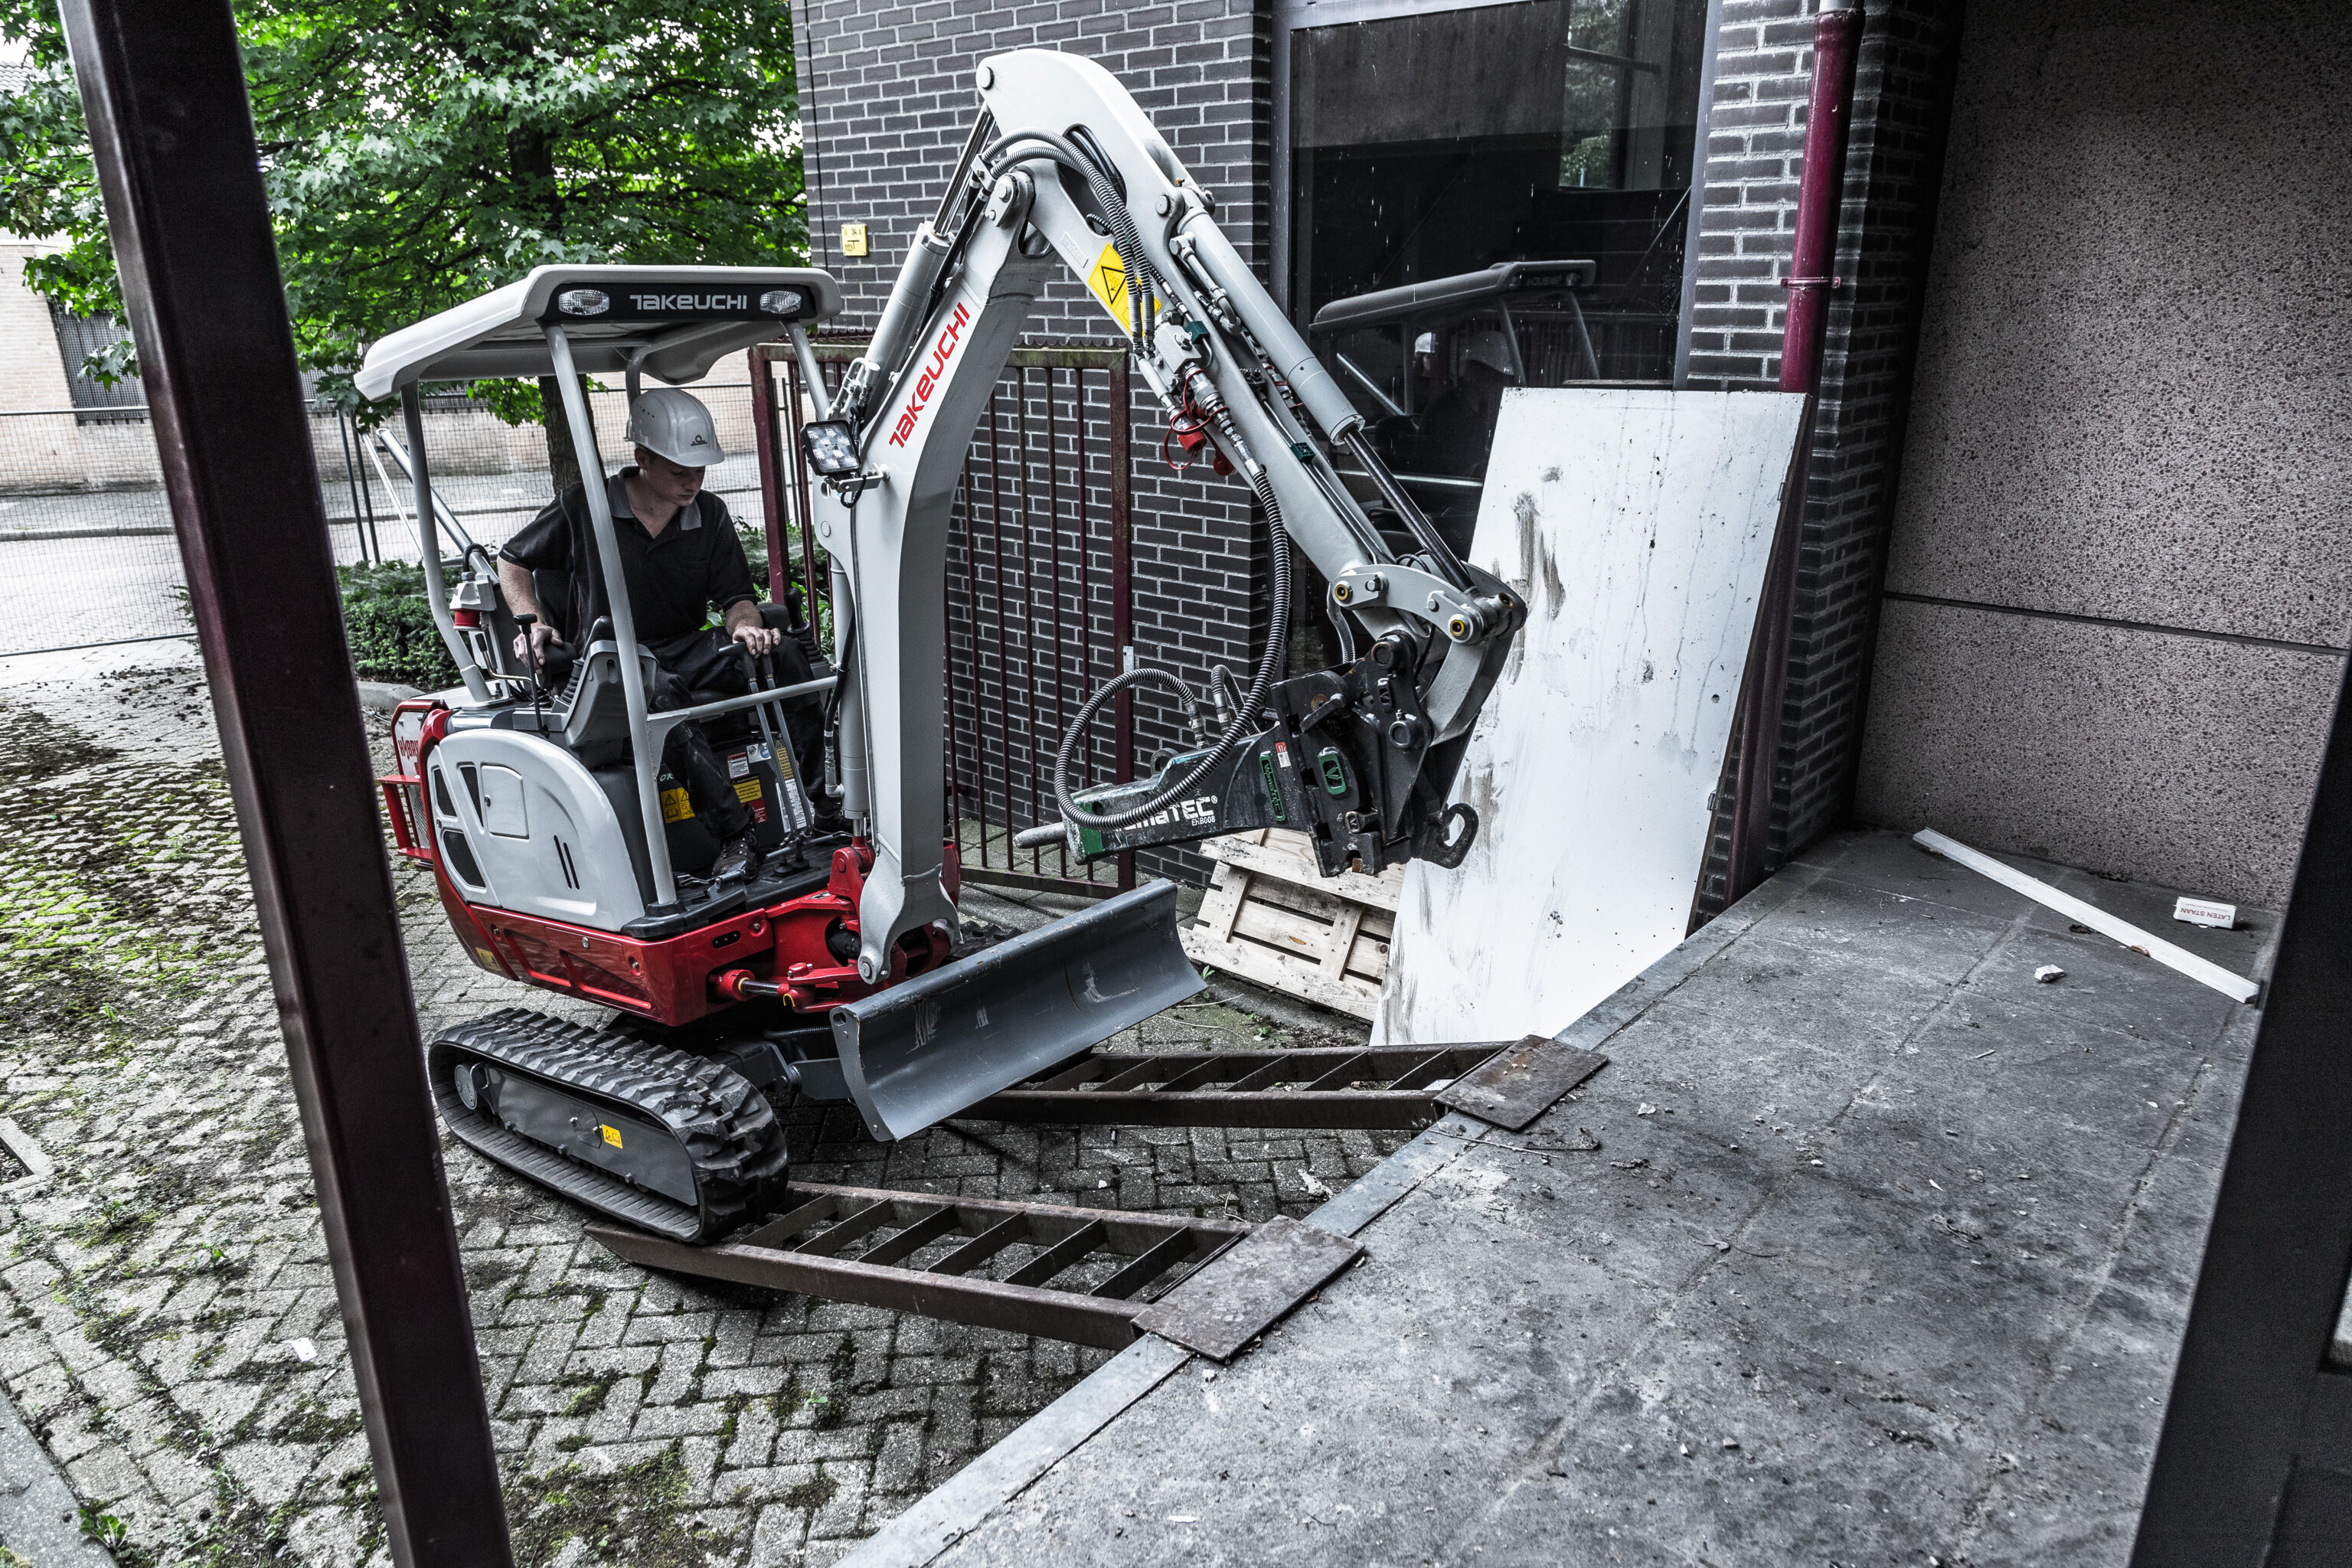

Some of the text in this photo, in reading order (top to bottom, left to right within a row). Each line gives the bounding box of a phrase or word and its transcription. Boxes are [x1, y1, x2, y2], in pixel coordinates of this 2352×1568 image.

[629, 295, 747, 310] TAKEUCHI
[889, 302, 970, 448] TAKEUCHI
[2207, 912, 2231, 920] LATEN
